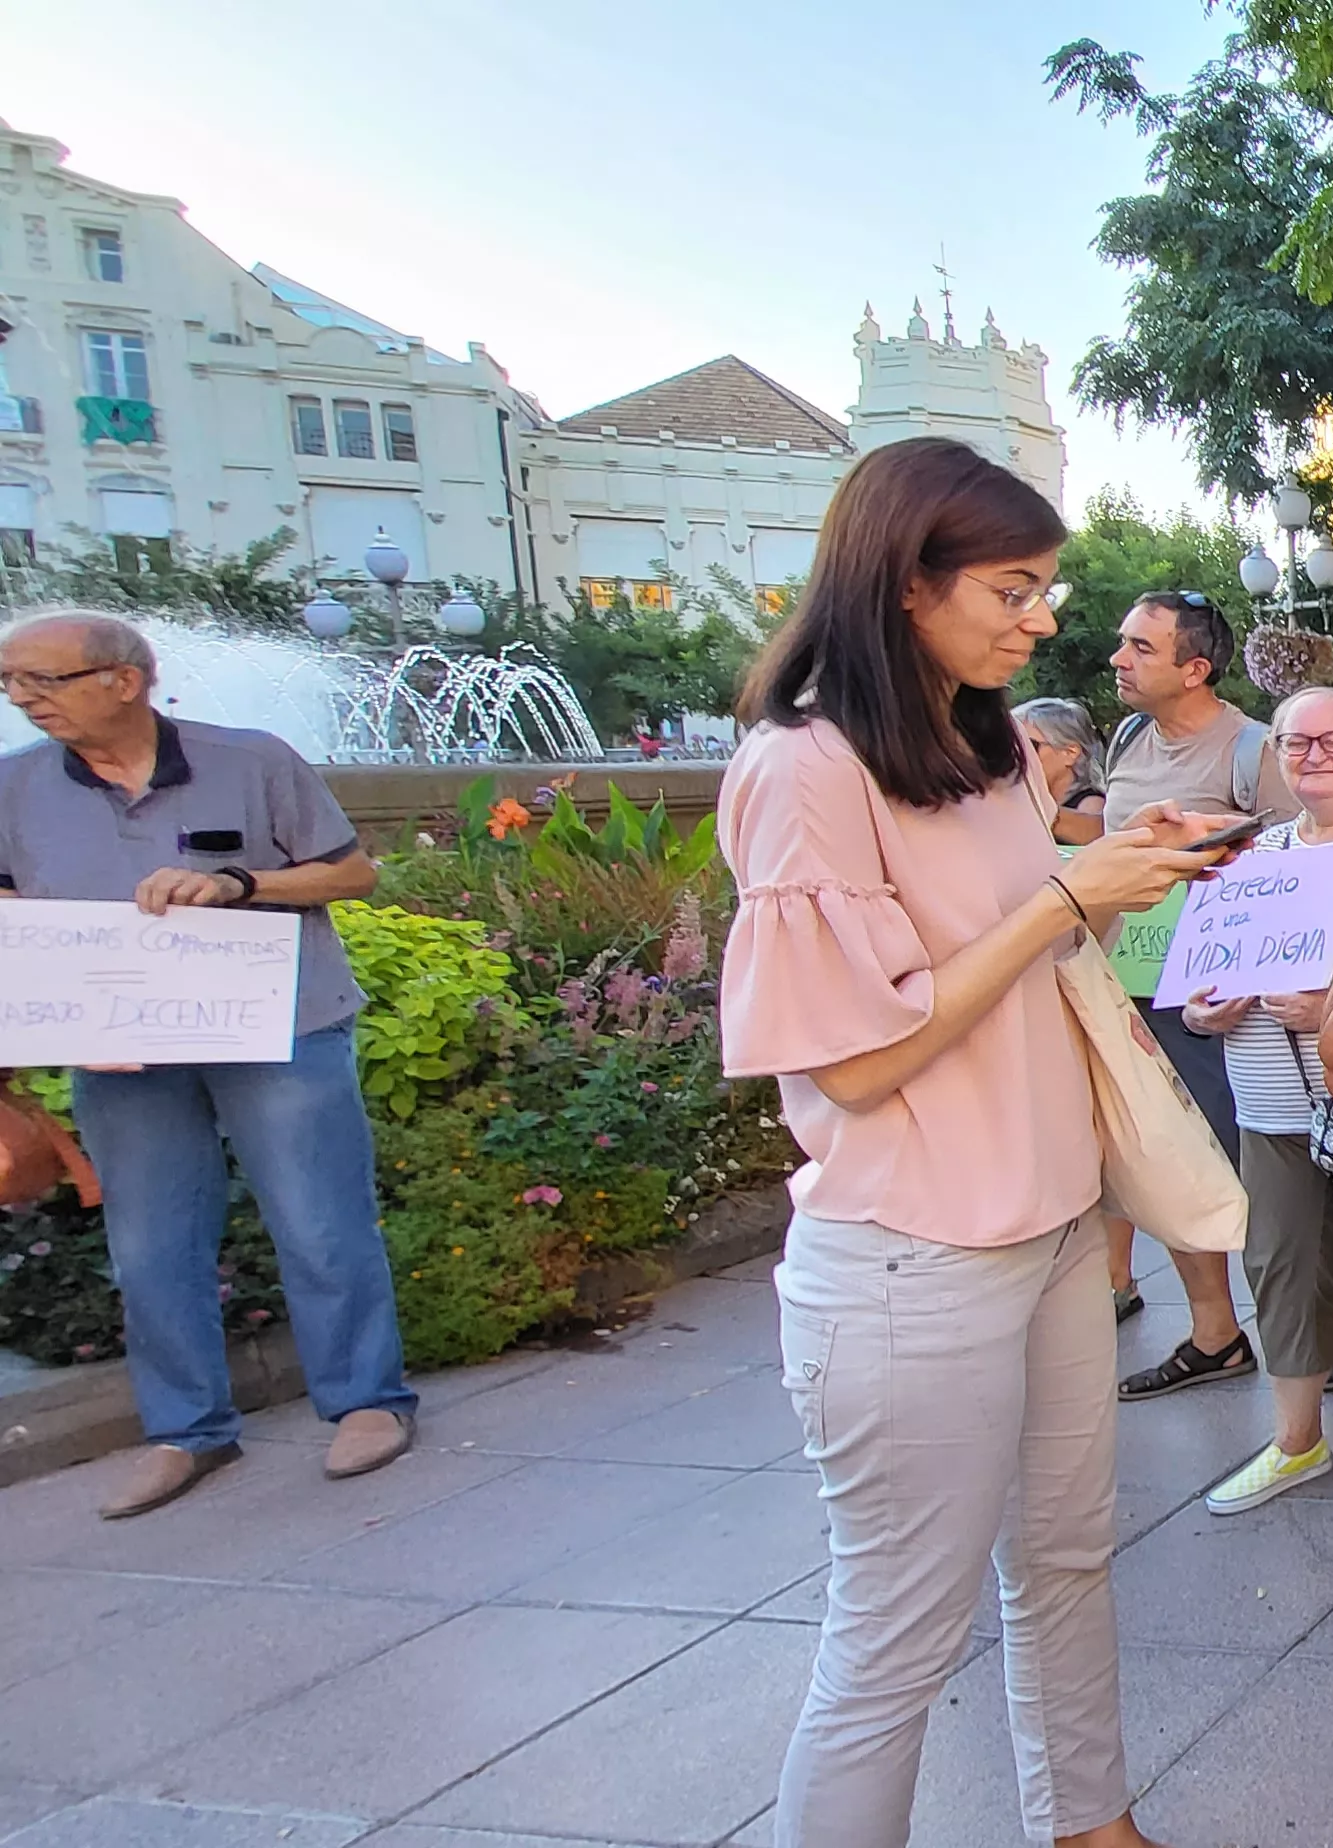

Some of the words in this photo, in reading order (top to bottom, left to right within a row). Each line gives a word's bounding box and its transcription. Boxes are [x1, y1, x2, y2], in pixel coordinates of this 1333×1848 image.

[1193, 869, 1300, 913] Derecho
[0, 912, 123, 950] ERSONAS
[1200, 920, 1213, 933] a
[1223, 911, 1251, 927] una
[1184, 941, 1242, 979] VIDA
[0, 1000, 84, 1030] ABAJO
